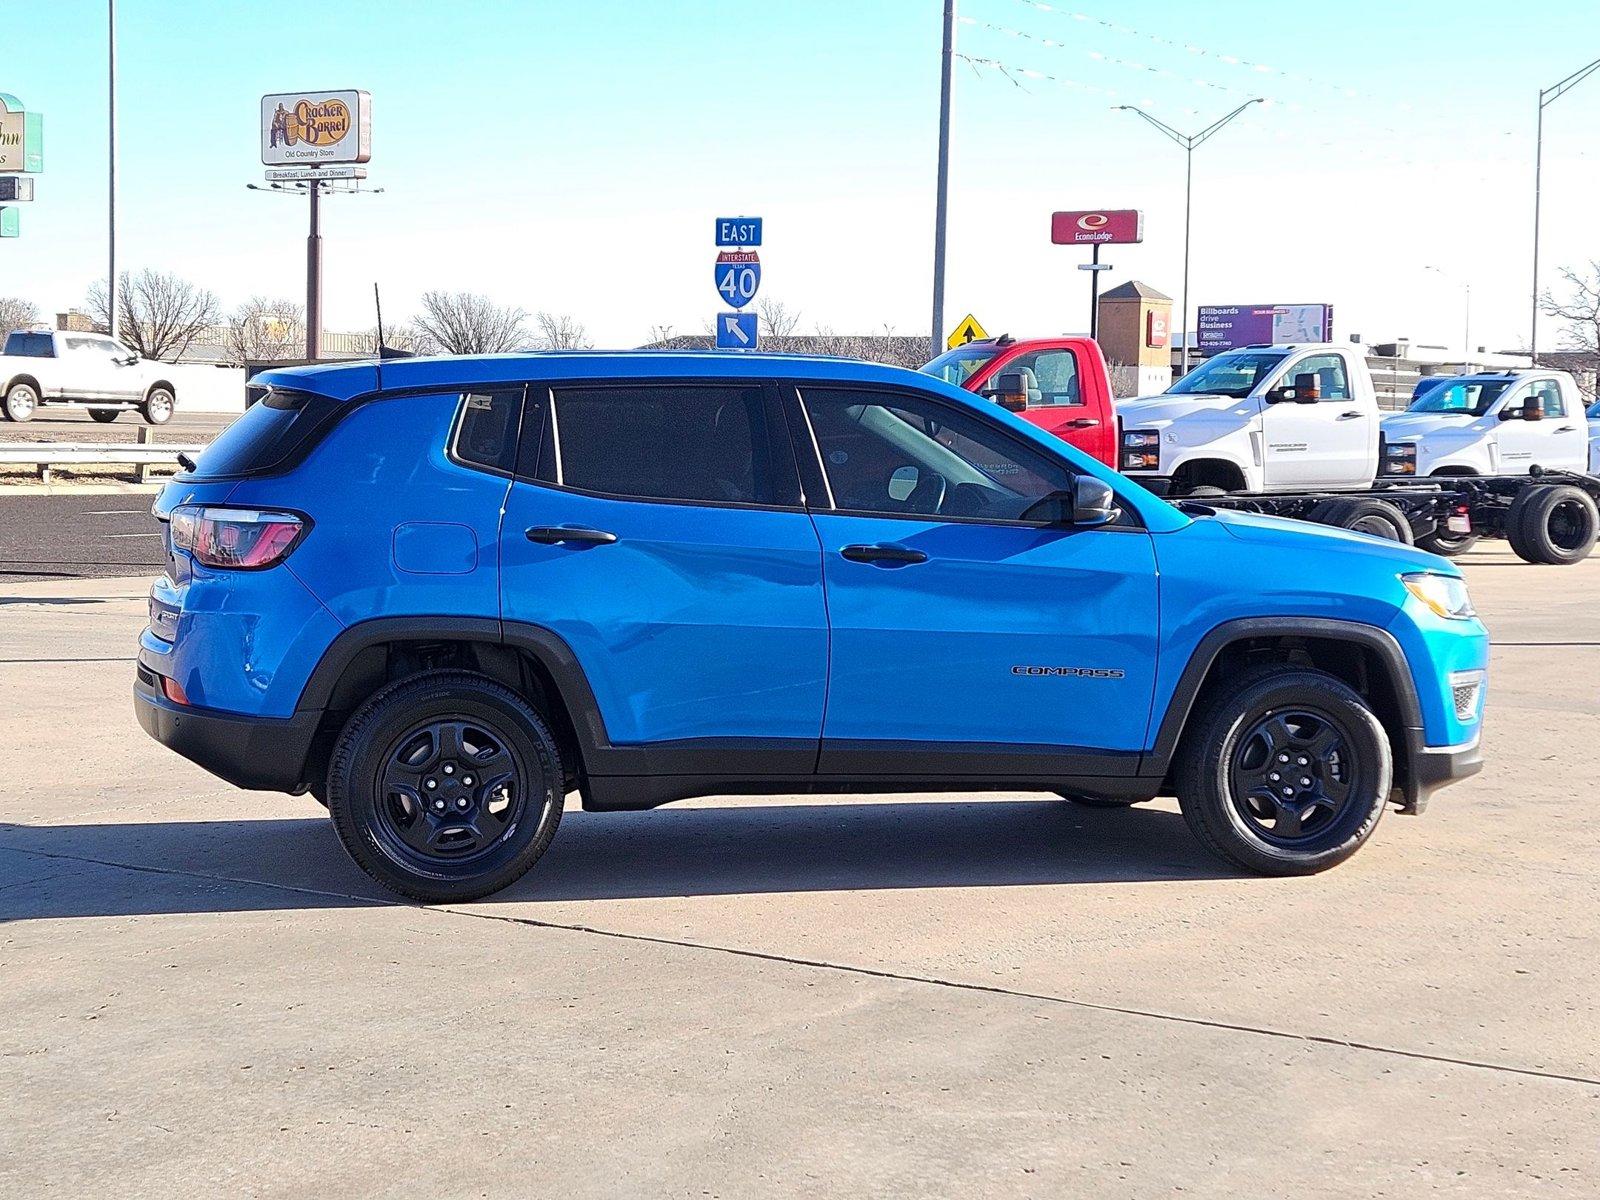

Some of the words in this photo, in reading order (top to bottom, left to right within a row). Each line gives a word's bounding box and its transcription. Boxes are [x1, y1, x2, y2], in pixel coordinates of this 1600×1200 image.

[295, 102, 343, 126] Cracker
[305, 118, 346, 143] Barrel
[285, 150, 294, 158] Old
[296, 148, 318, 158] Country
[319, 148, 335, 157] Store
[272, 171, 300, 179] Breakfast,
[300, 170, 317, 178] Lunch
[722, 222, 755, 241] EAST
[721, 253, 755, 262] INTERSTATE
[719, 268, 756, 298] 40
[1200, 307, 1239, 315] Billboards
[1011, 665, 1126, 679] COMPASS
